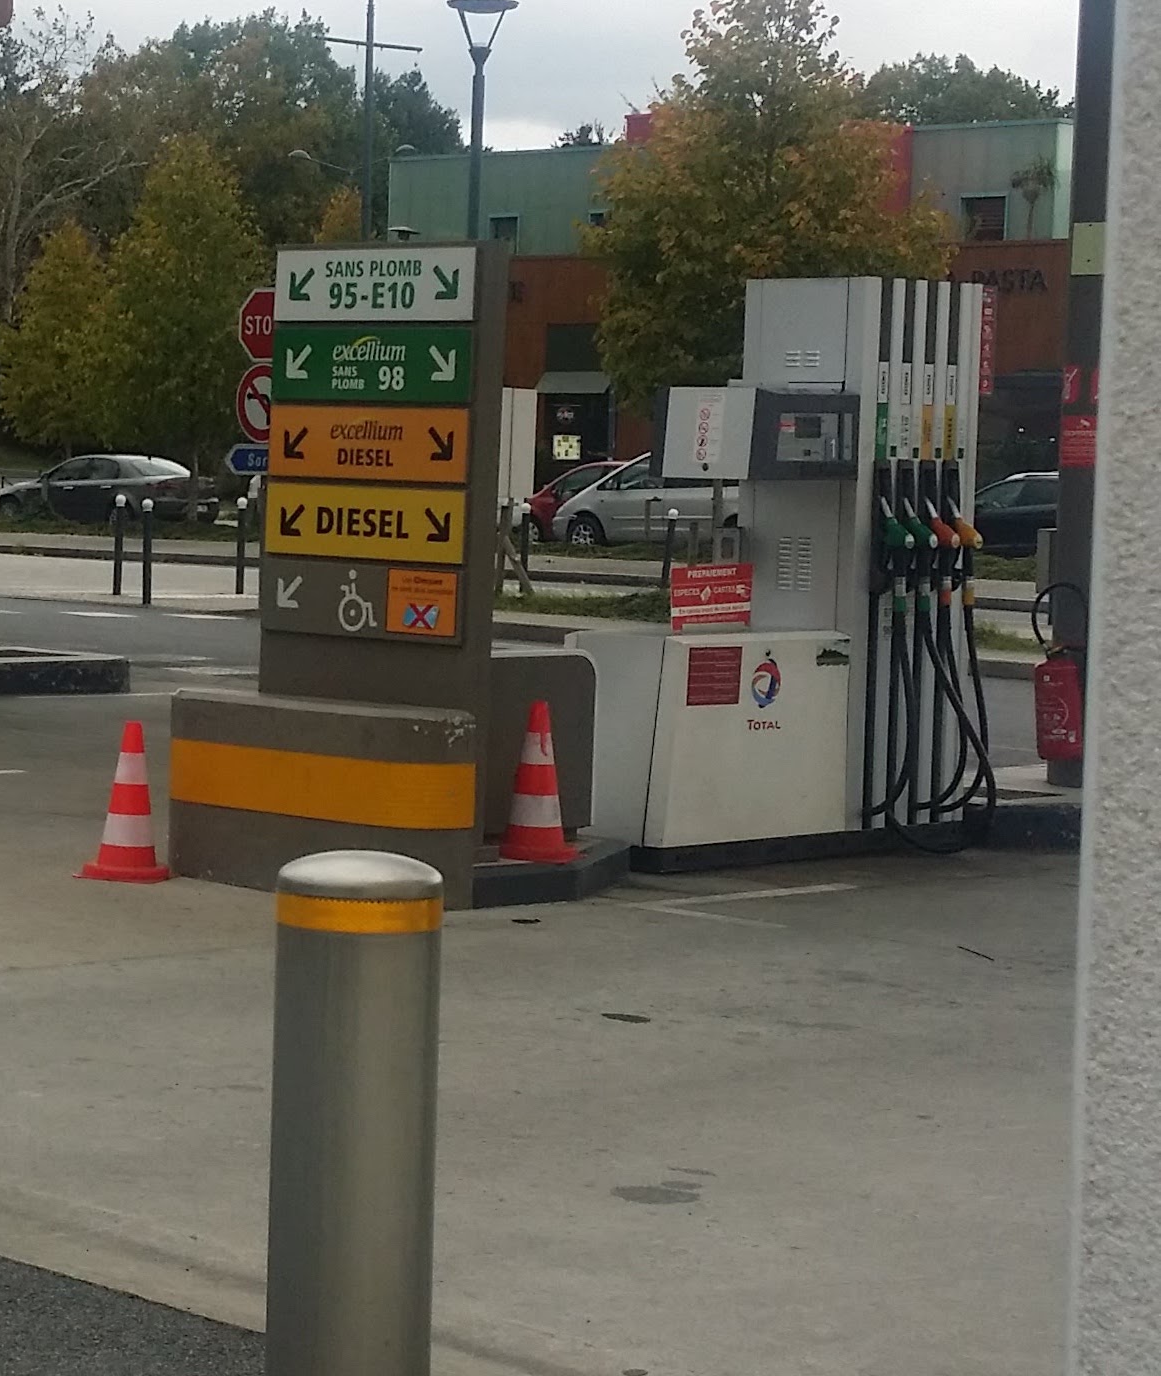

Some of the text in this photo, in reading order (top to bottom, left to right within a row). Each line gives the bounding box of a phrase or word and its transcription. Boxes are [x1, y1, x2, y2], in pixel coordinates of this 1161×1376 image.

[325, 259, 422, 278] SANS PLOMB
[329, 281, 415, 309] 95-E10
[244, 315, 272, 335] STO
[332, 340, 406, 362] excellium
[332, 366, 358, 377] SANS
[378, 365, 405, 391] 98
[331, 378, 365, 390] PLOMB
[330, 420, 404, 441] excellium
[247, 453, 269, 467] Sor
[337, 448, 394, 467] DIESEL
[316, 506, 409, 539] DIESEL
[746, 719, 781, 731] TOTAL
